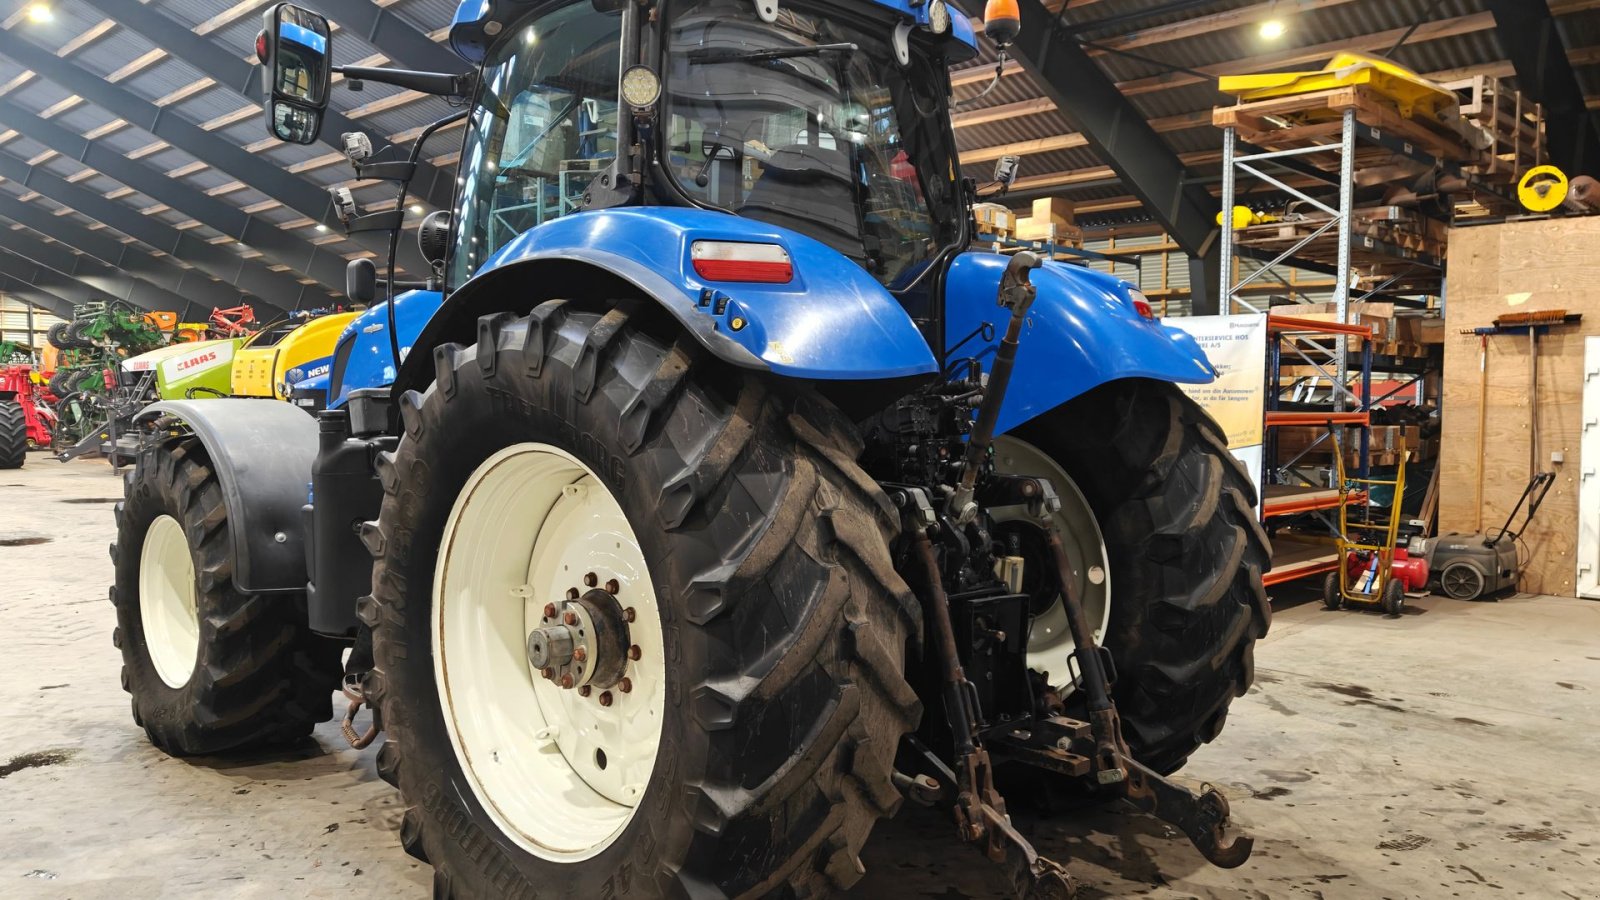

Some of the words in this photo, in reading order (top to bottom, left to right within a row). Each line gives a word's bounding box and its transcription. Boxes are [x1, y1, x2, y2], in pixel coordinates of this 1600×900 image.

[133, 360, 150, 370] CLAAS
[177, 351, 217, 371] CLAAS
[307, 364, 330, 378] NEW
